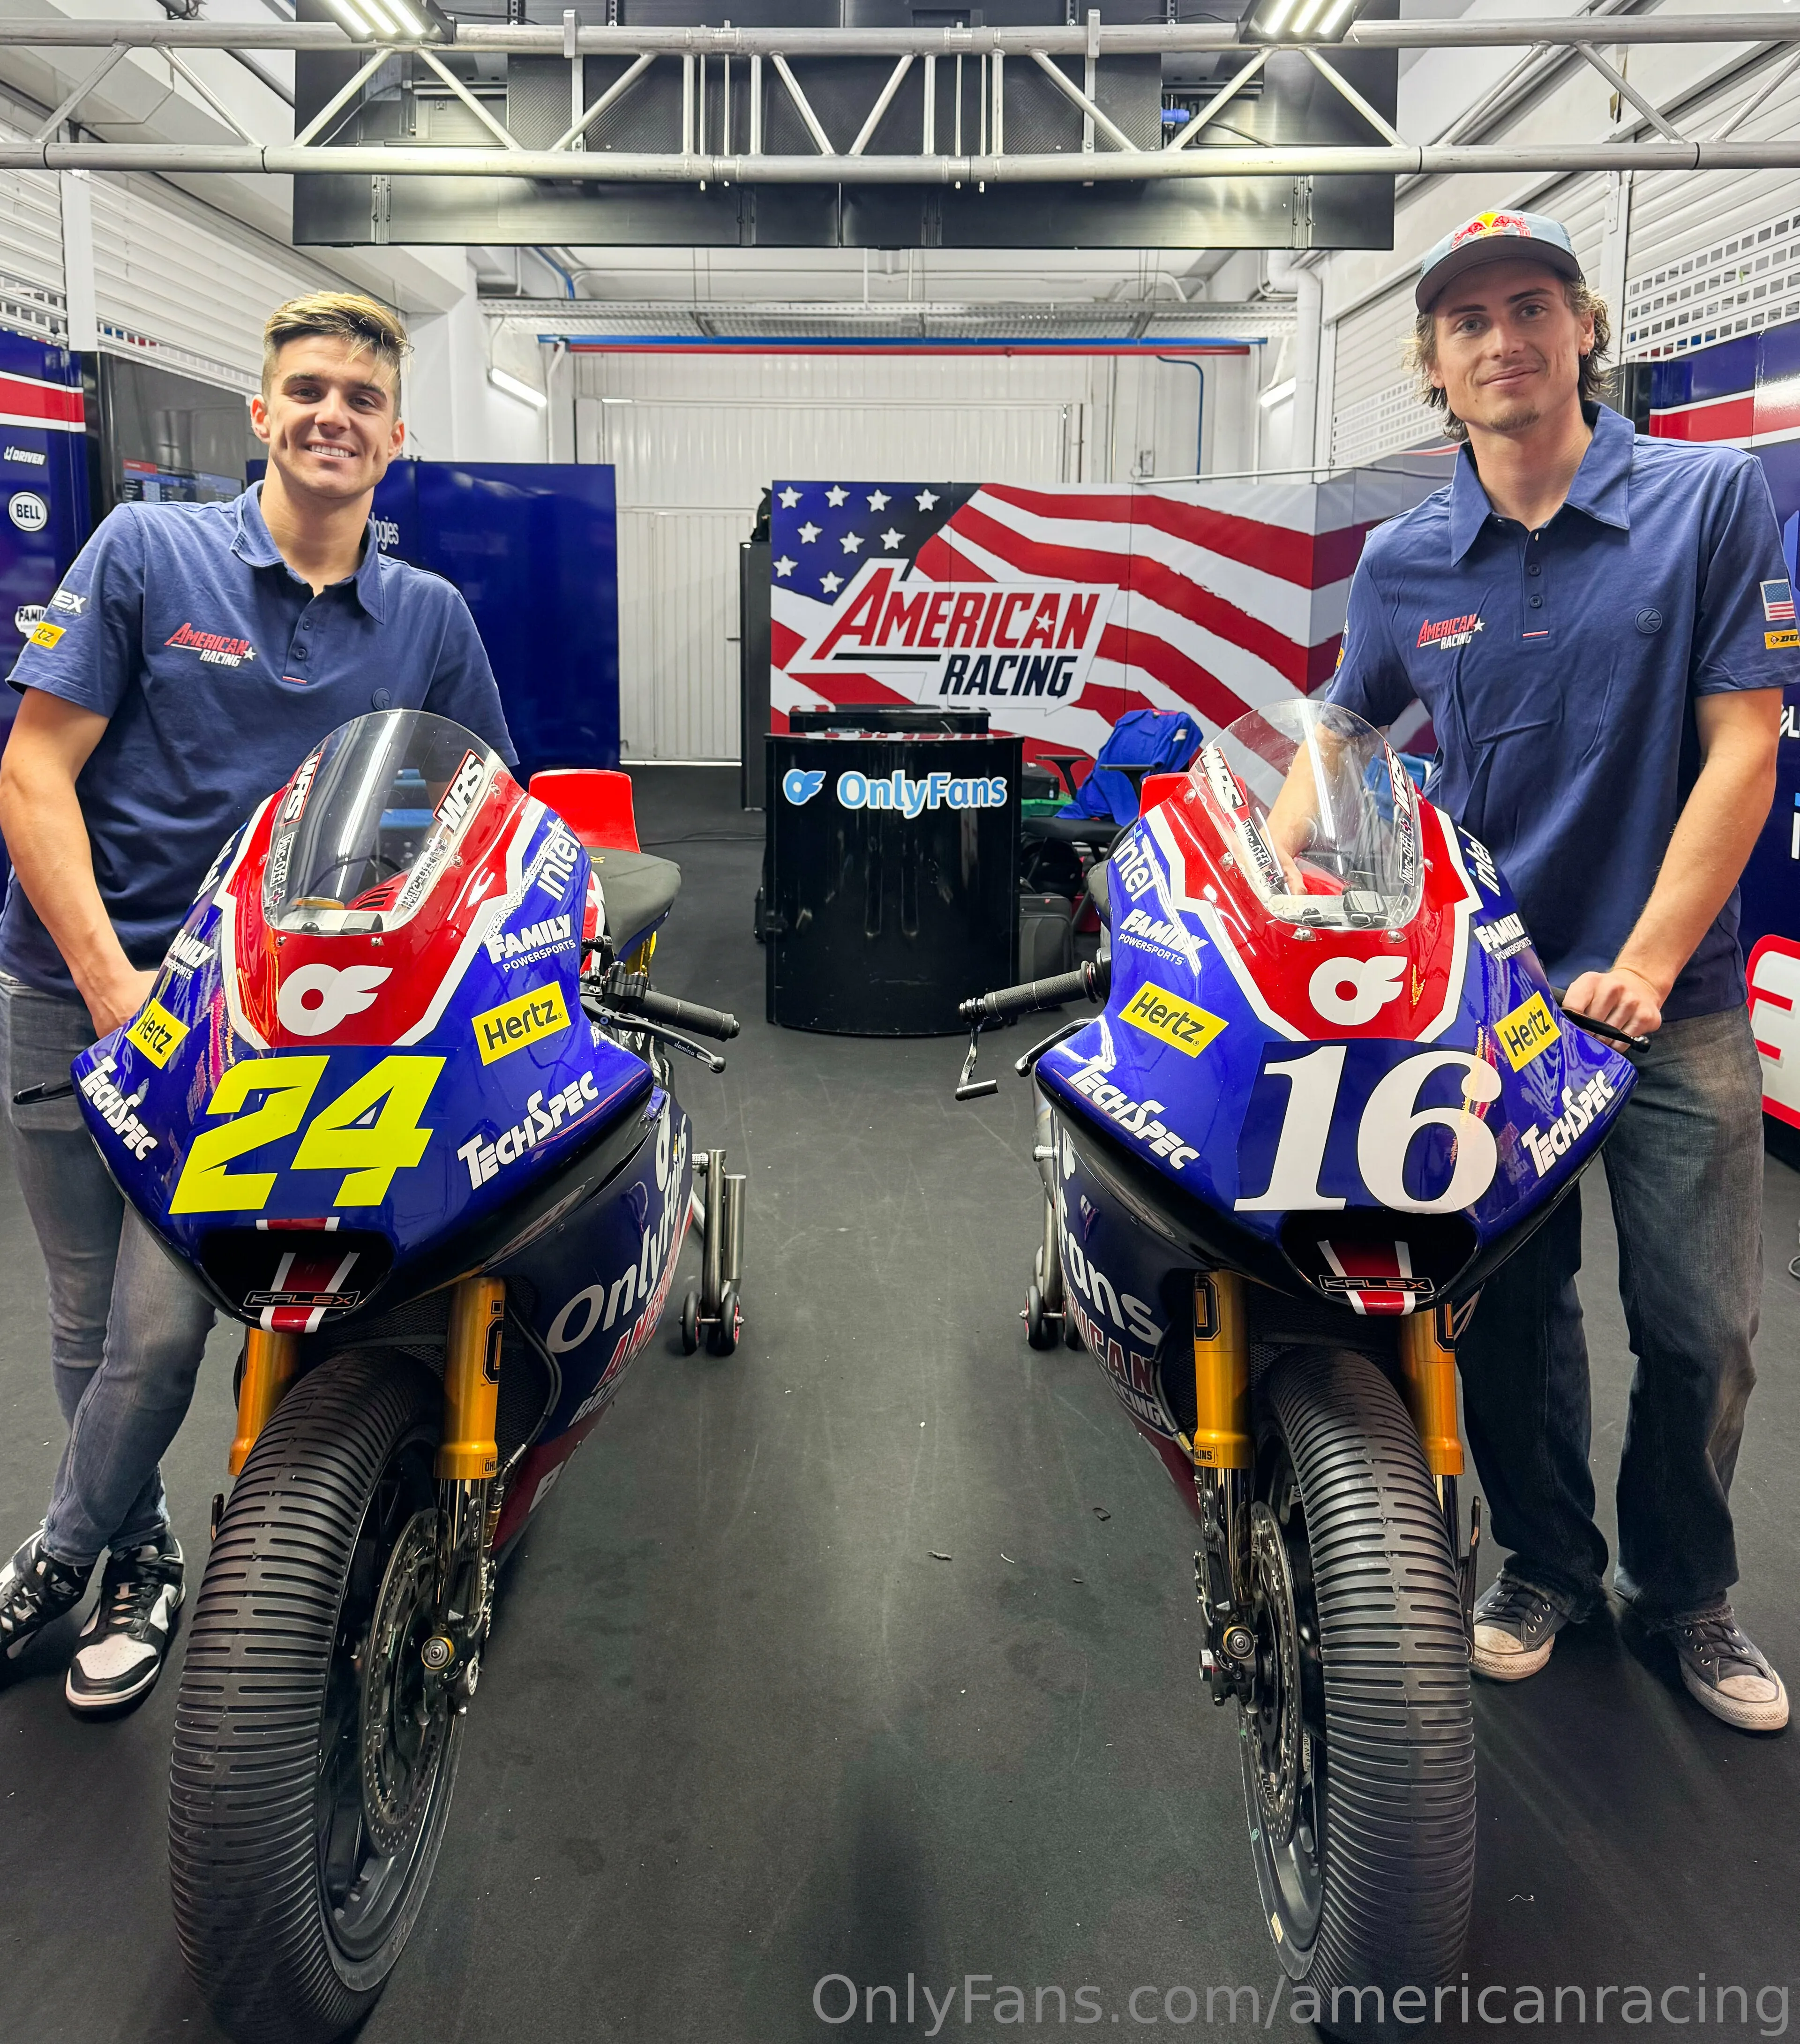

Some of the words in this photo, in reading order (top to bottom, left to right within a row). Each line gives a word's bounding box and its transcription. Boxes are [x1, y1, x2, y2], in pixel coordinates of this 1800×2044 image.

[12, 450, 45, 465] DRIVEN
[16, 503, 41, 519] BELL
[810, 567, 1100, 660] AMERICAN
[1417, 613, 1478, 647] AMERICAN
[165, 623, 250, 655] AMERICAN
[199, 648, 241, 667] RACING
[1440, 631, 1472, 650] RACING
[939, 654, 1077, 699] RACING
[284, 753, 321, 820] WRS
[439, 753, 485, 833] WRS
[837, 769, 1007, 819] OnlyFans
[168, 928, 216, 968] FAMILY
[486, 914, 572, 963] FAMILY
[1118, 933, 1184, 965] POWERSPORTS
[1121, 908, 1208, 957] FAMILY
[1473, 913, 1525, 954] FAMILY
[1495, 937, 1532, 962] POWERSPORTS
[502, 939, 576, 973] POWERSPORTS
[136, 1009, 172, 1055] Hertz
[483, 999, 558, 1050] Hertz
[1132, 992, 1205, 1044] Hertz
[1503, 1005, 1551, 1057] Hertz
[674, 1041, 695, 1056] domino
[168, 1055, 447, 1214] 24
[1234, 1045, 1501, 1214] 16
[249, 1294, 353, 1305] KALEX
[1325, 1278, 1429, 1290] KALEX
